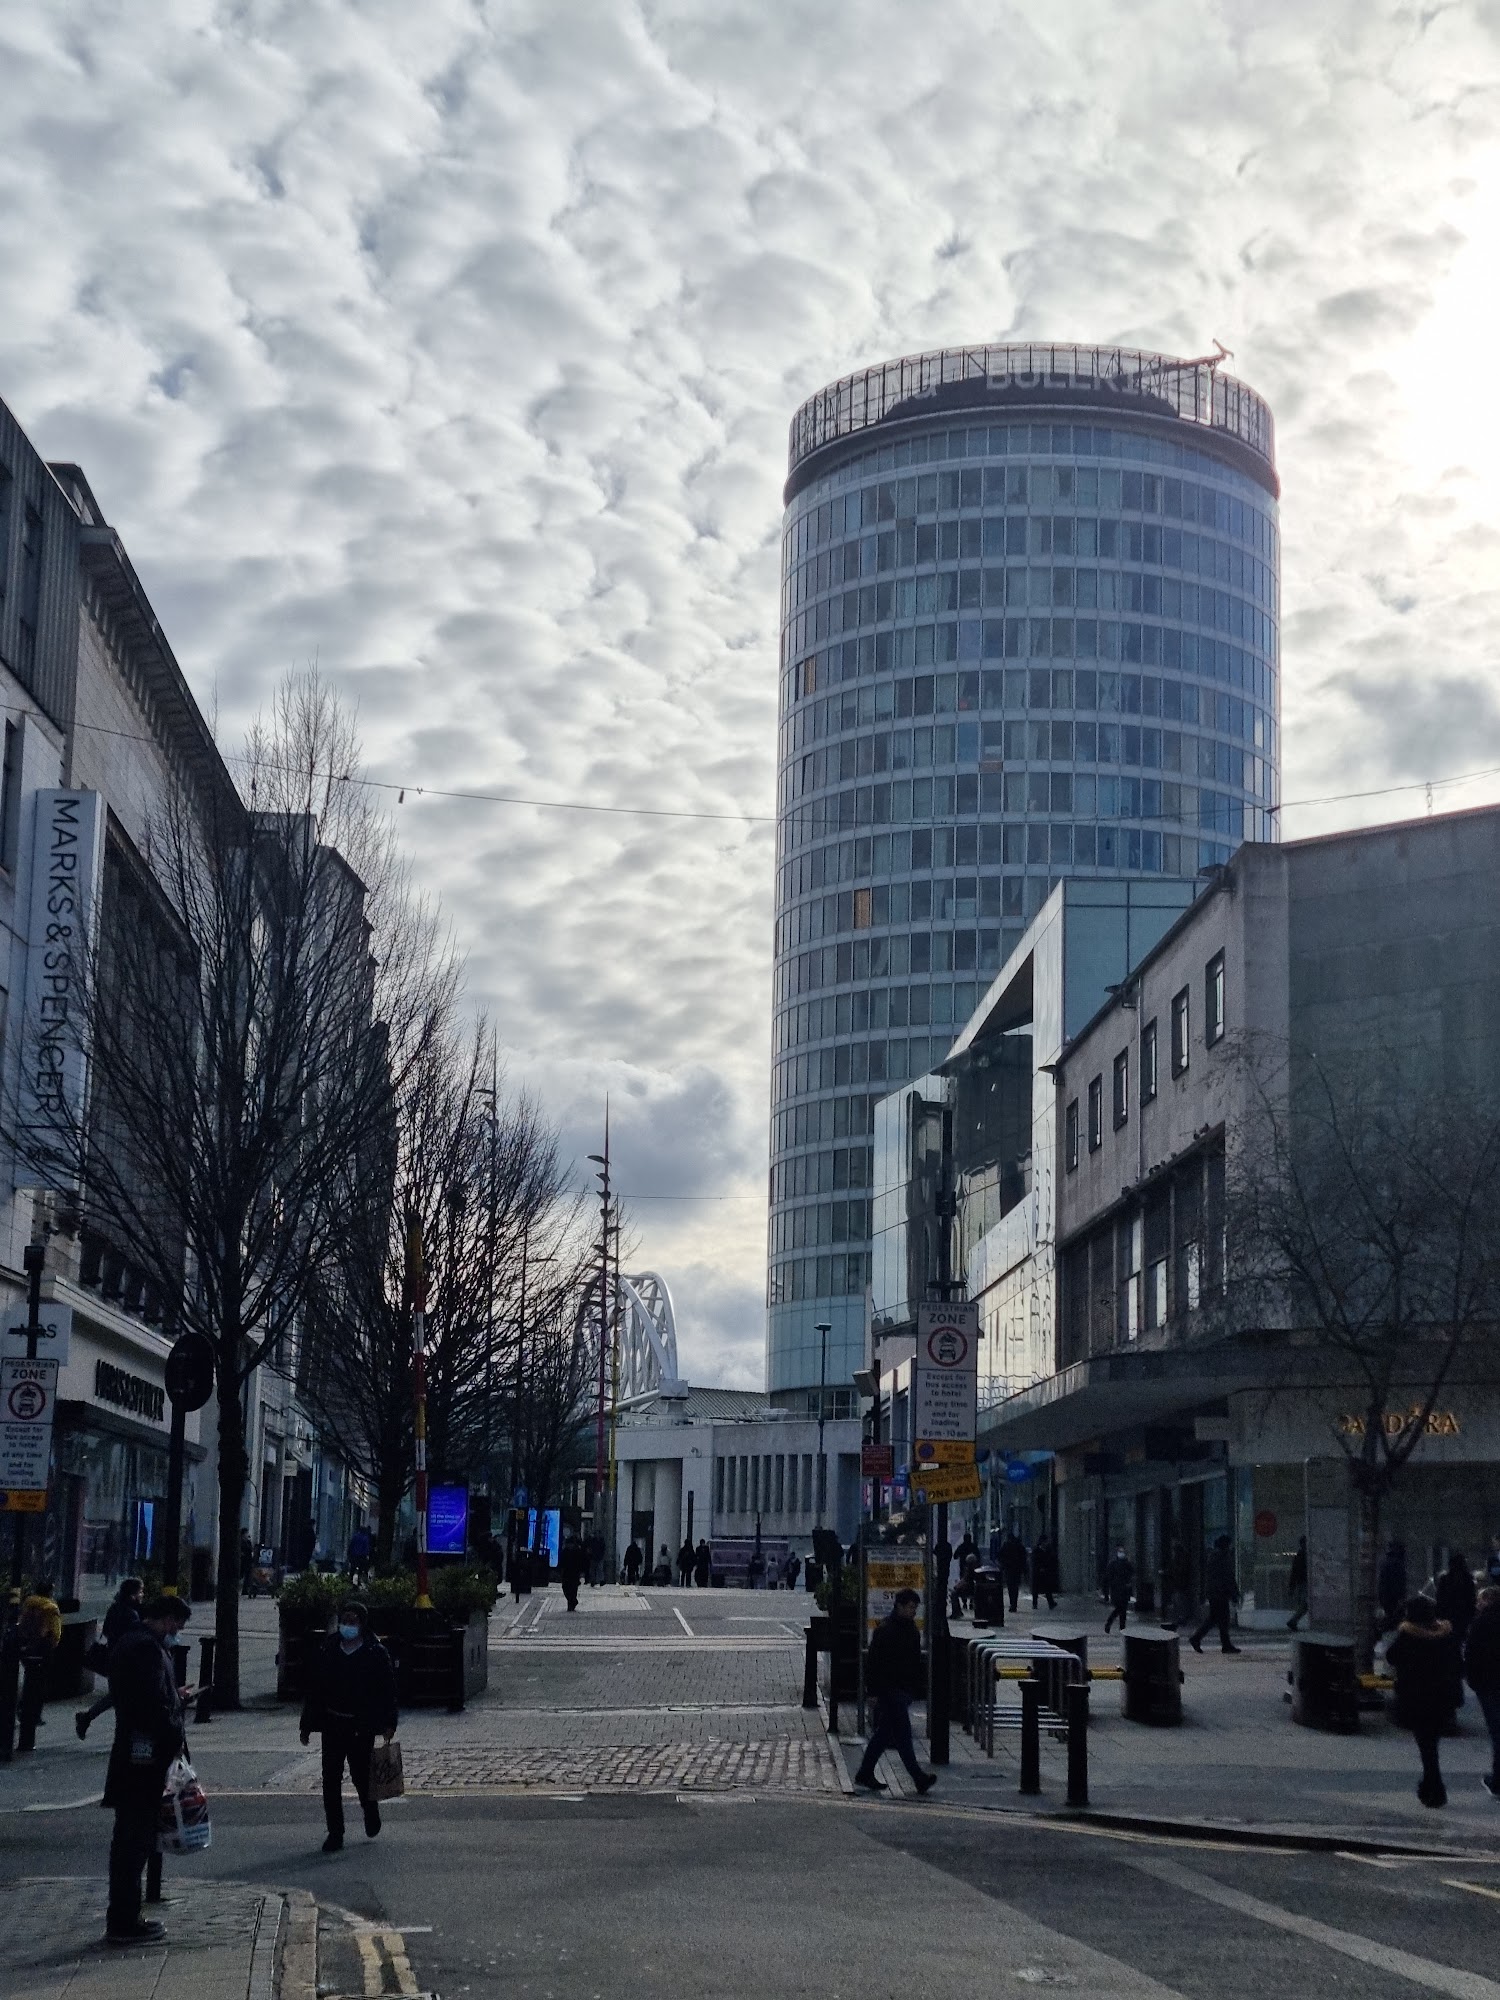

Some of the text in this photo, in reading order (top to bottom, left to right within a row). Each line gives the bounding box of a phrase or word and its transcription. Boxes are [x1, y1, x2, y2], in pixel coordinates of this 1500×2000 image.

[34, 799, 80, 1113] MARKS & SPENCER
[921, 1304, 975, 1313] PEDESTRIAN
[929, 1313, 967, 1325] ZONE
[4, 1360, 56, 1369] PEDESTRIAN
[11, 1369, 47, 1380] ZONE
[926, 1372, 953, 1381] Except
[931, 1389, 939, 1397] to
[934, 1401, 948, 1409] any
[930, 1419, 960, 1427] loading
[928, 1484, 977, 1499] ONE WAY
